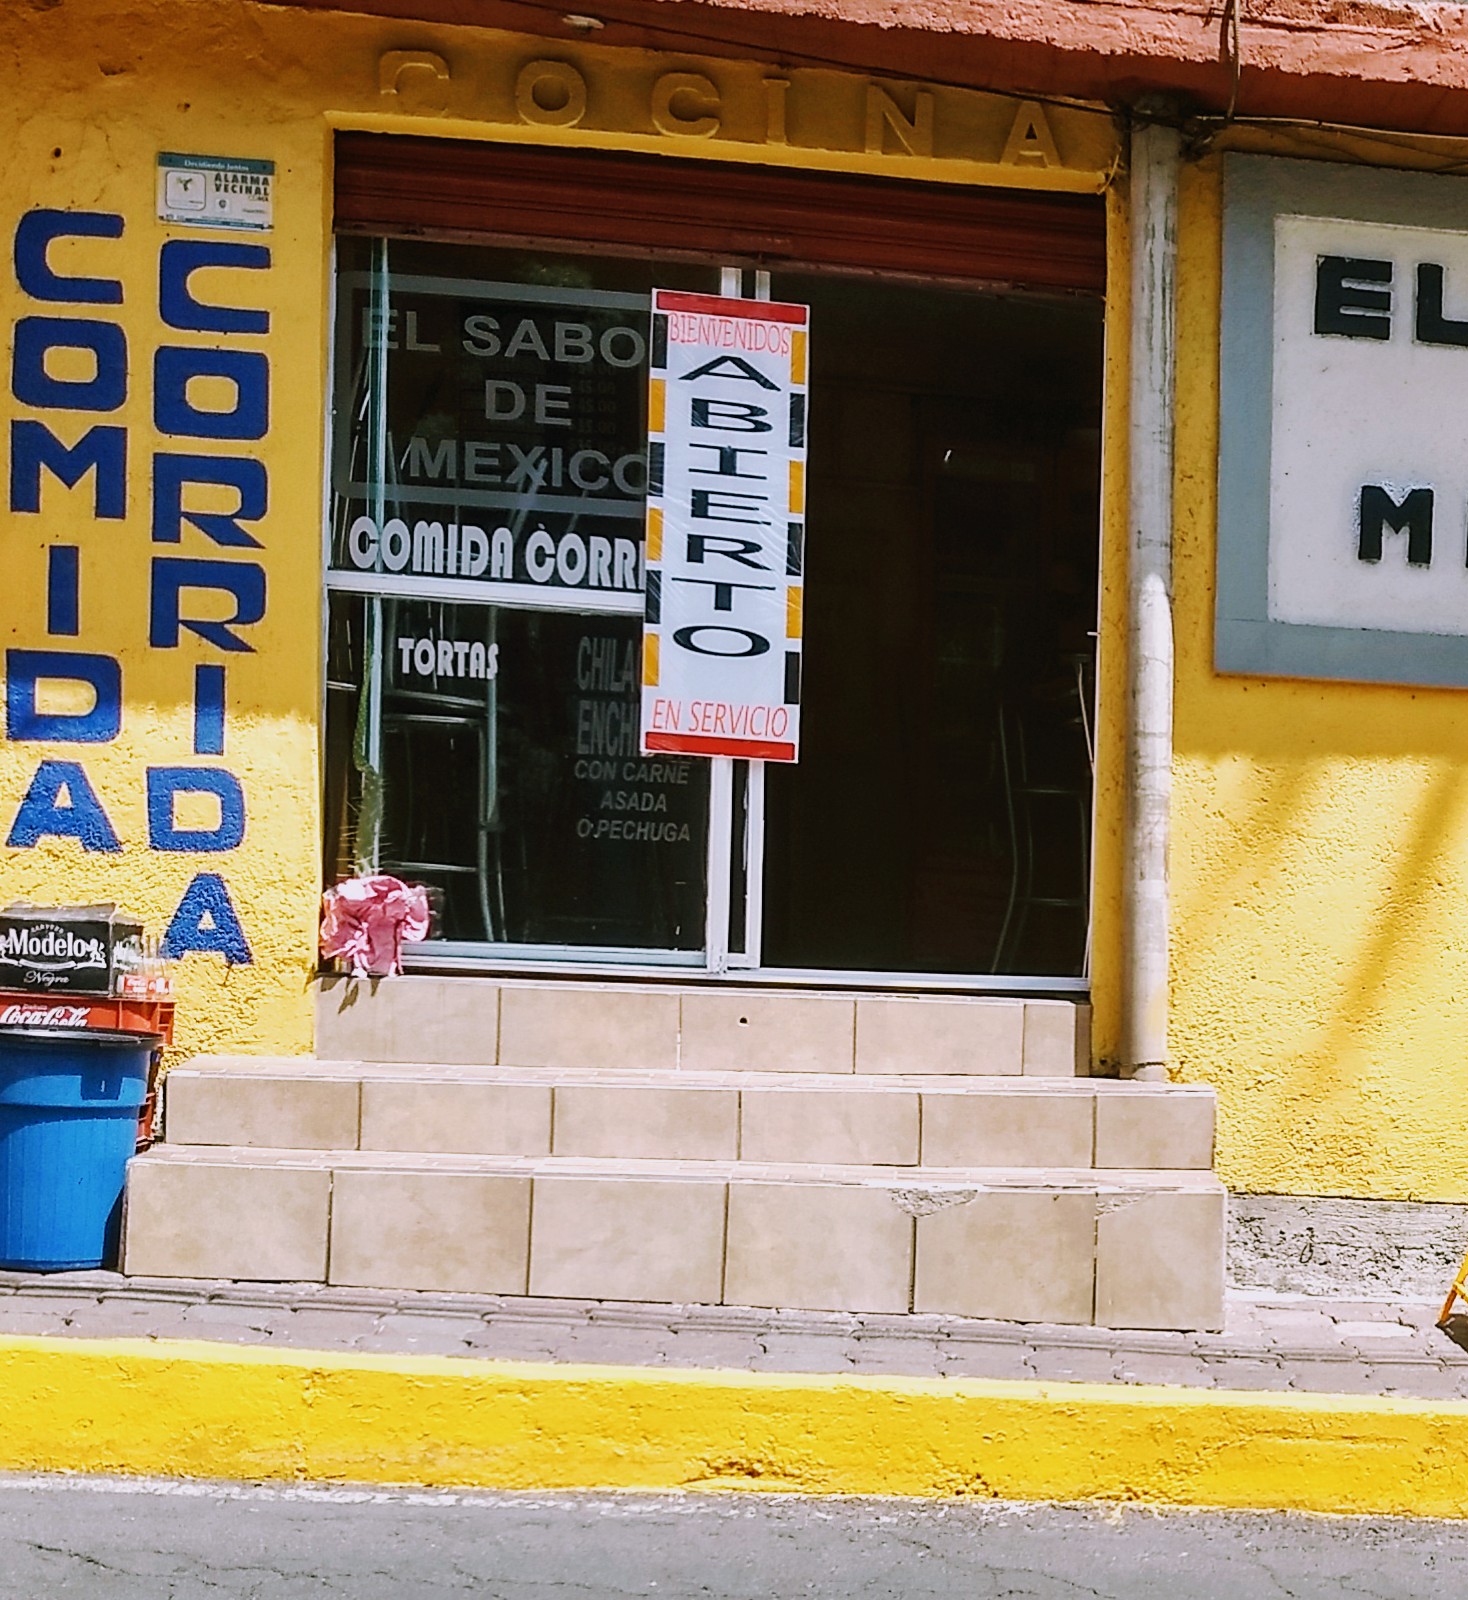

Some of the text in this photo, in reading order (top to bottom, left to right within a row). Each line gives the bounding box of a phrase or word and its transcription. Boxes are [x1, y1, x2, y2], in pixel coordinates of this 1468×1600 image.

[378, 50, 1063, 169] COCINA
[215, 173, 269, 186] ALARMA
[215, 184, 269, 196] VECINAL
[361, 307, 645, 369] EL SABO
[668, 313, 791, 356] BIENVENIDOS
[485, 379, 572, 427] DE
[409, 437, 646, 496] MEXICO
[672, 355, 782, 657] ABIERTO
[5, 208, 129, 853] COMIDA
[349, 515, 645, 590] COMIDA CORRI
[145, 238, 272, 965] CORRIDA
[398, 637, 499, 680] TORTAS
[577, 636, 634, 692] CHILA
[577, 700, 639, 757] ENCHI
[652, 699, 788, 738] EN SERVICIO
[574, 760, 689, 784] CON CARNE
[600, 790, 667, 812] ASADA
[8, 928, 87, 957] Modelo
[23, 970, 70, 987] Negra
